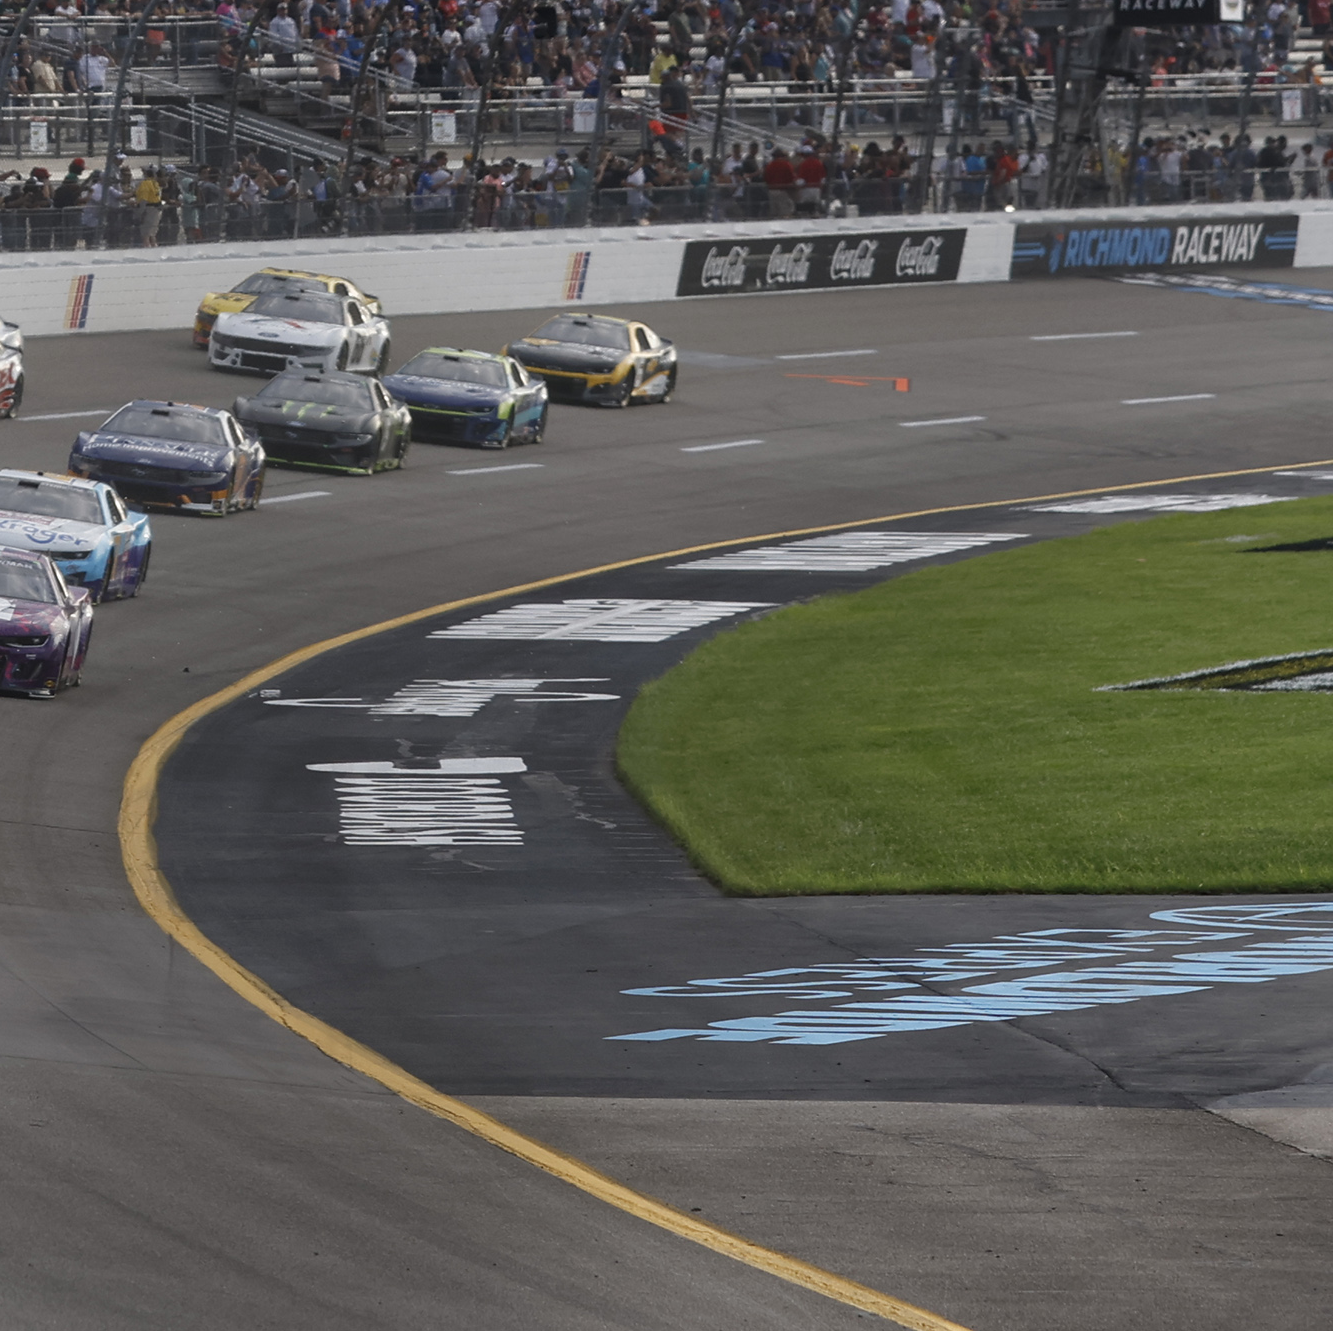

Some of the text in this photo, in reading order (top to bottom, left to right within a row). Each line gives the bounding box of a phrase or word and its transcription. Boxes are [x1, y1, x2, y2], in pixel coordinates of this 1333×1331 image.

[767, 242, 813, 283] Coca-Cola
[831, 239, 879, 280] Coca-Cola
[896, 236, 944, 276] Coca-Cola
[1064, 222, 1264, 268] RICHMOND RACEWAY
[702, 245, 750, 288] Coca-Cola
[123, 443, 215, 467] Improvements
[334, 777, 526, 846] DOORDASH
[619, 928, 1255, 1000] EXPRESS
